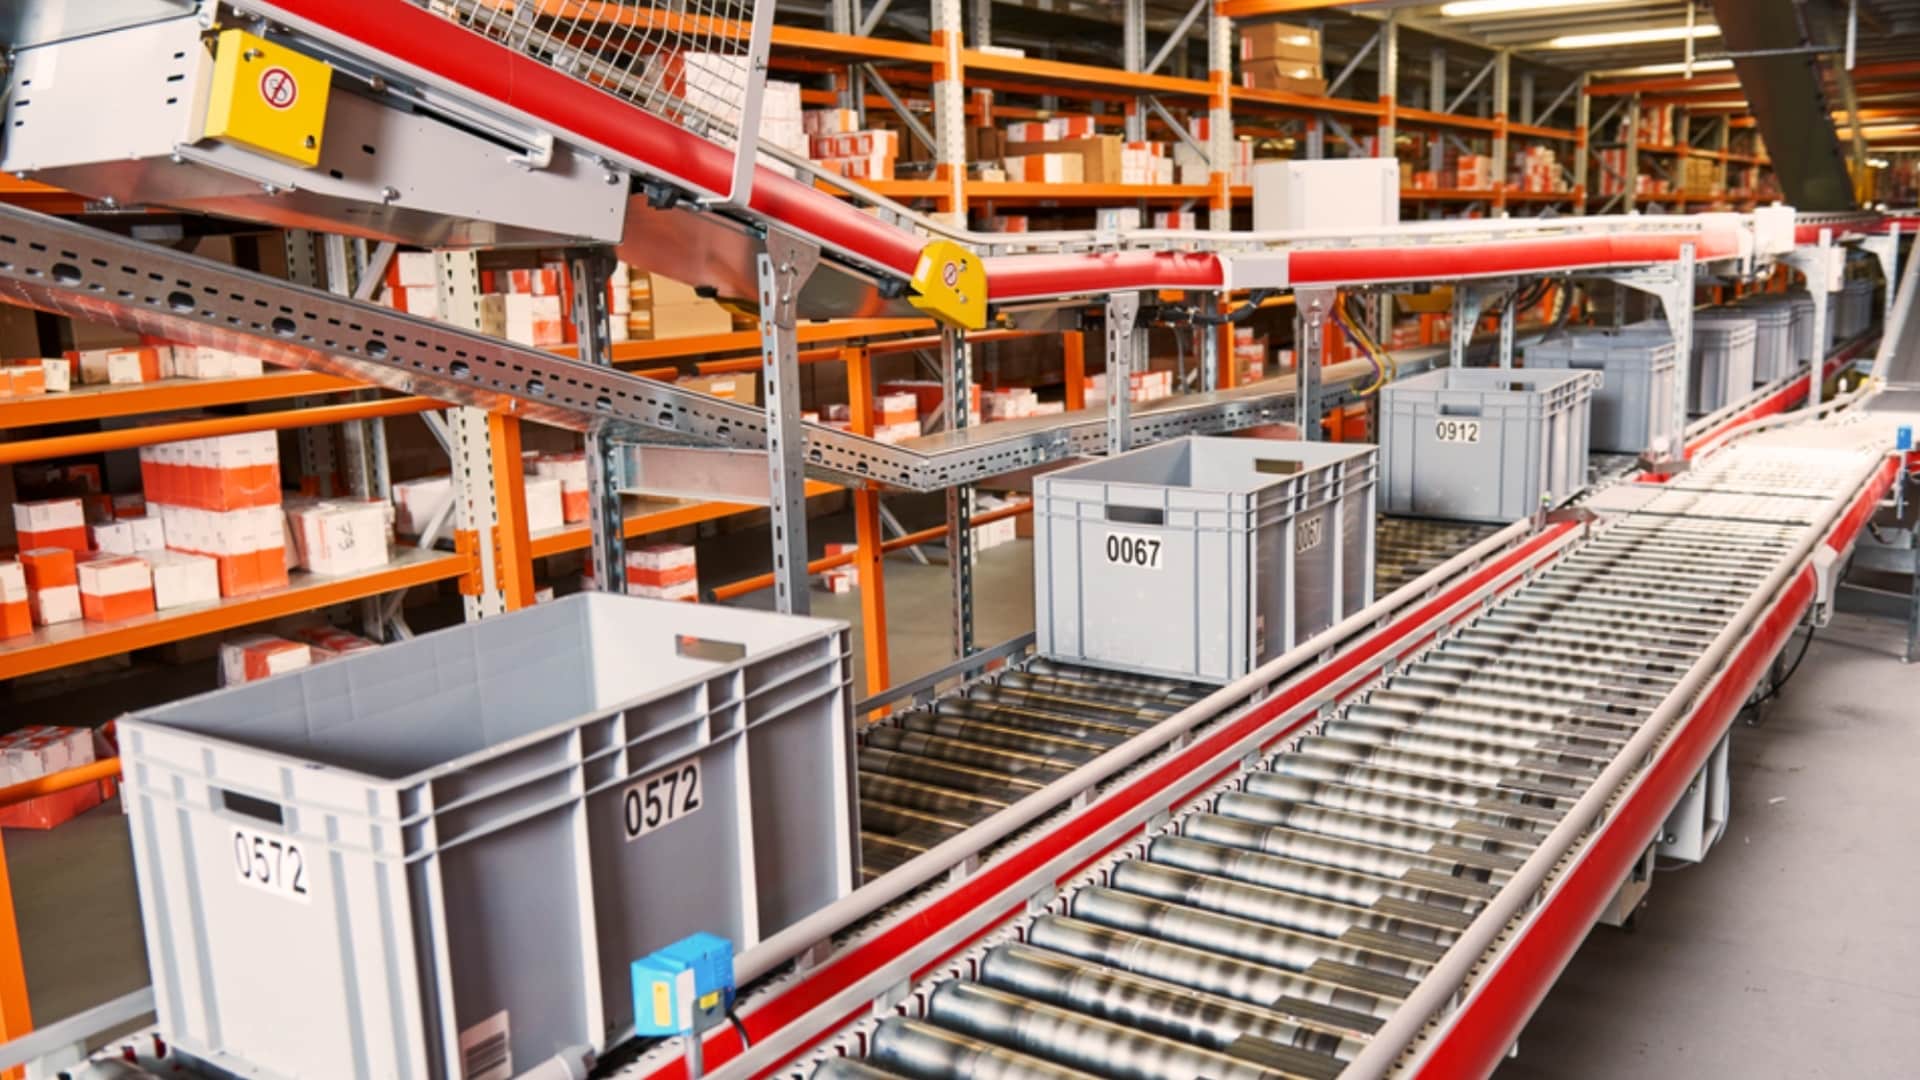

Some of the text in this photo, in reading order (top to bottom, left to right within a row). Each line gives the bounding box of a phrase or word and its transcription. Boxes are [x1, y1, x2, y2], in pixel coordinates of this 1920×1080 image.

[1436, 421, 1478, 442] 0912
[1107, 534, 1160, 567] 0067
[1296, 518, 1321, 551] 0067
[625, 764, 699, 836] 0572
[233, 831, 307, 894] 0572
